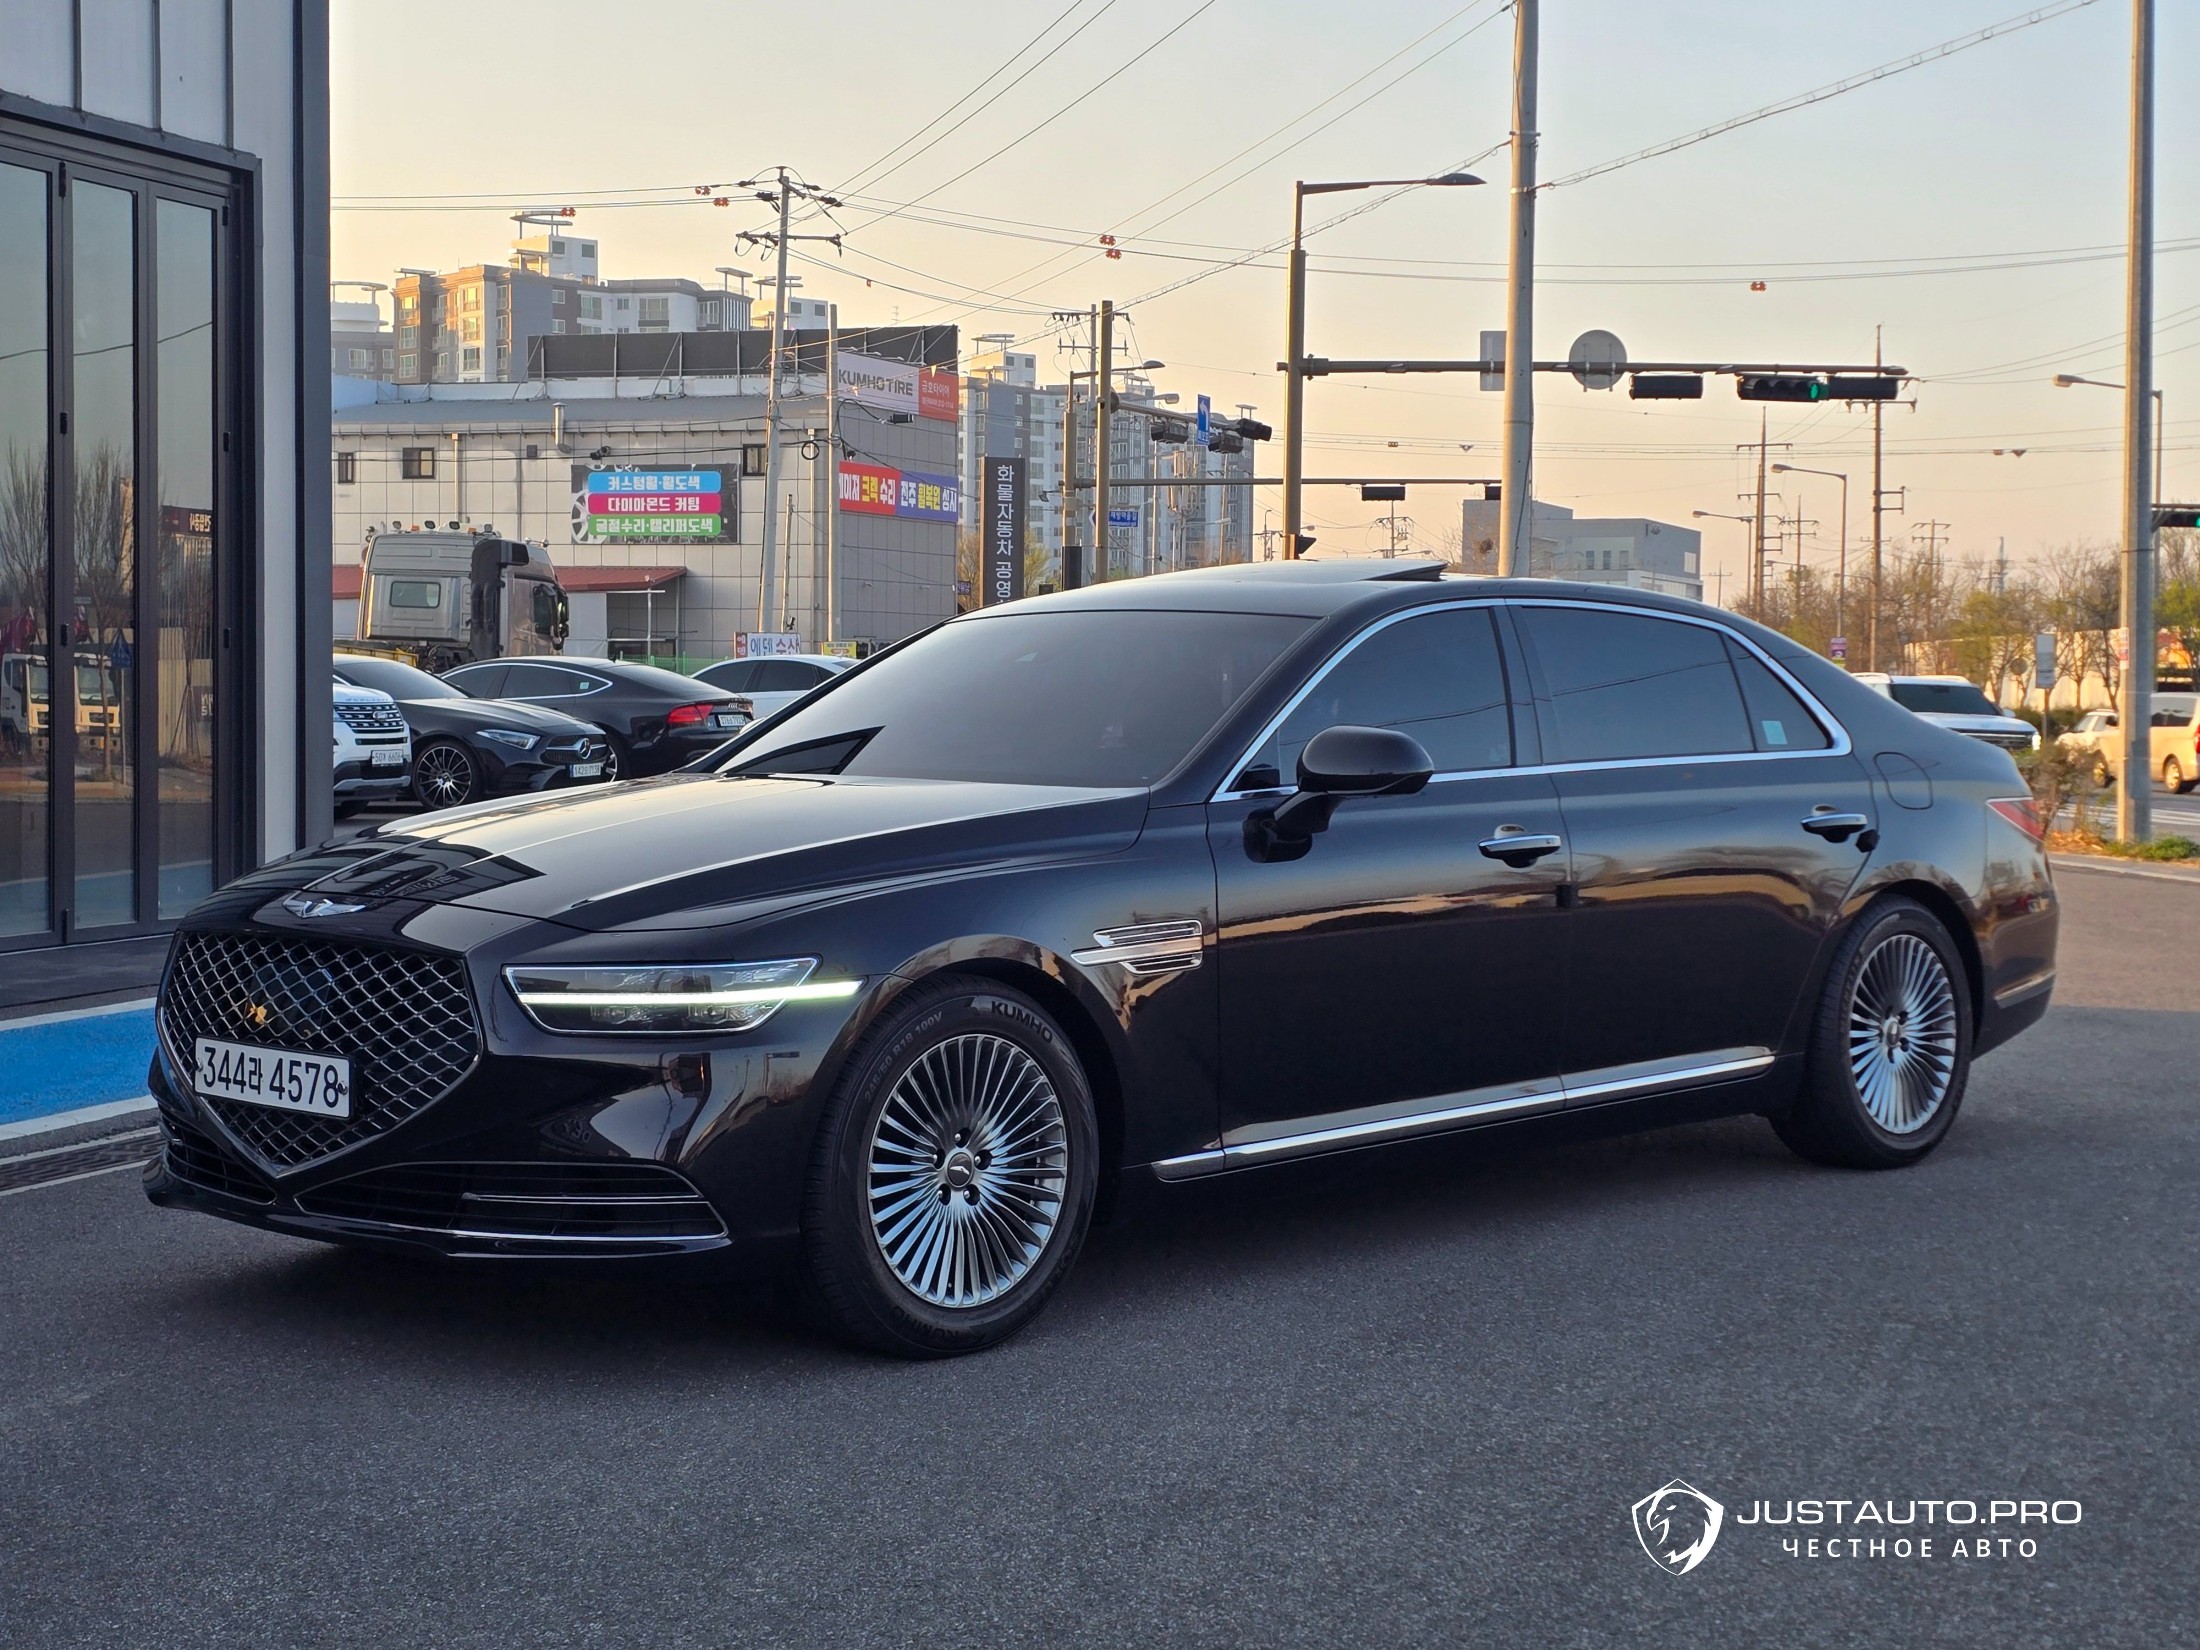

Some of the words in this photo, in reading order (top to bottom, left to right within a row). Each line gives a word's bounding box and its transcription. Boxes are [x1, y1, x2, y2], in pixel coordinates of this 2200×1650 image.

[607, 496, 671, 512] 다이아몬드
[674, 496, 700, 512] 커팅
[862, 475, 879, 503] 크랙
[880, 477, 896, 506] 수리
[996, 465, 1014, 556] 화물자동차
[995, 561, 1013, 604] 공영
[915, 1011, 942, 1035] 100V
[991, 1000, 1053, 1043] KUMHO
[203, 1046, 263, 1095] 344라
[269, 1057, 340, 1108] 4578
